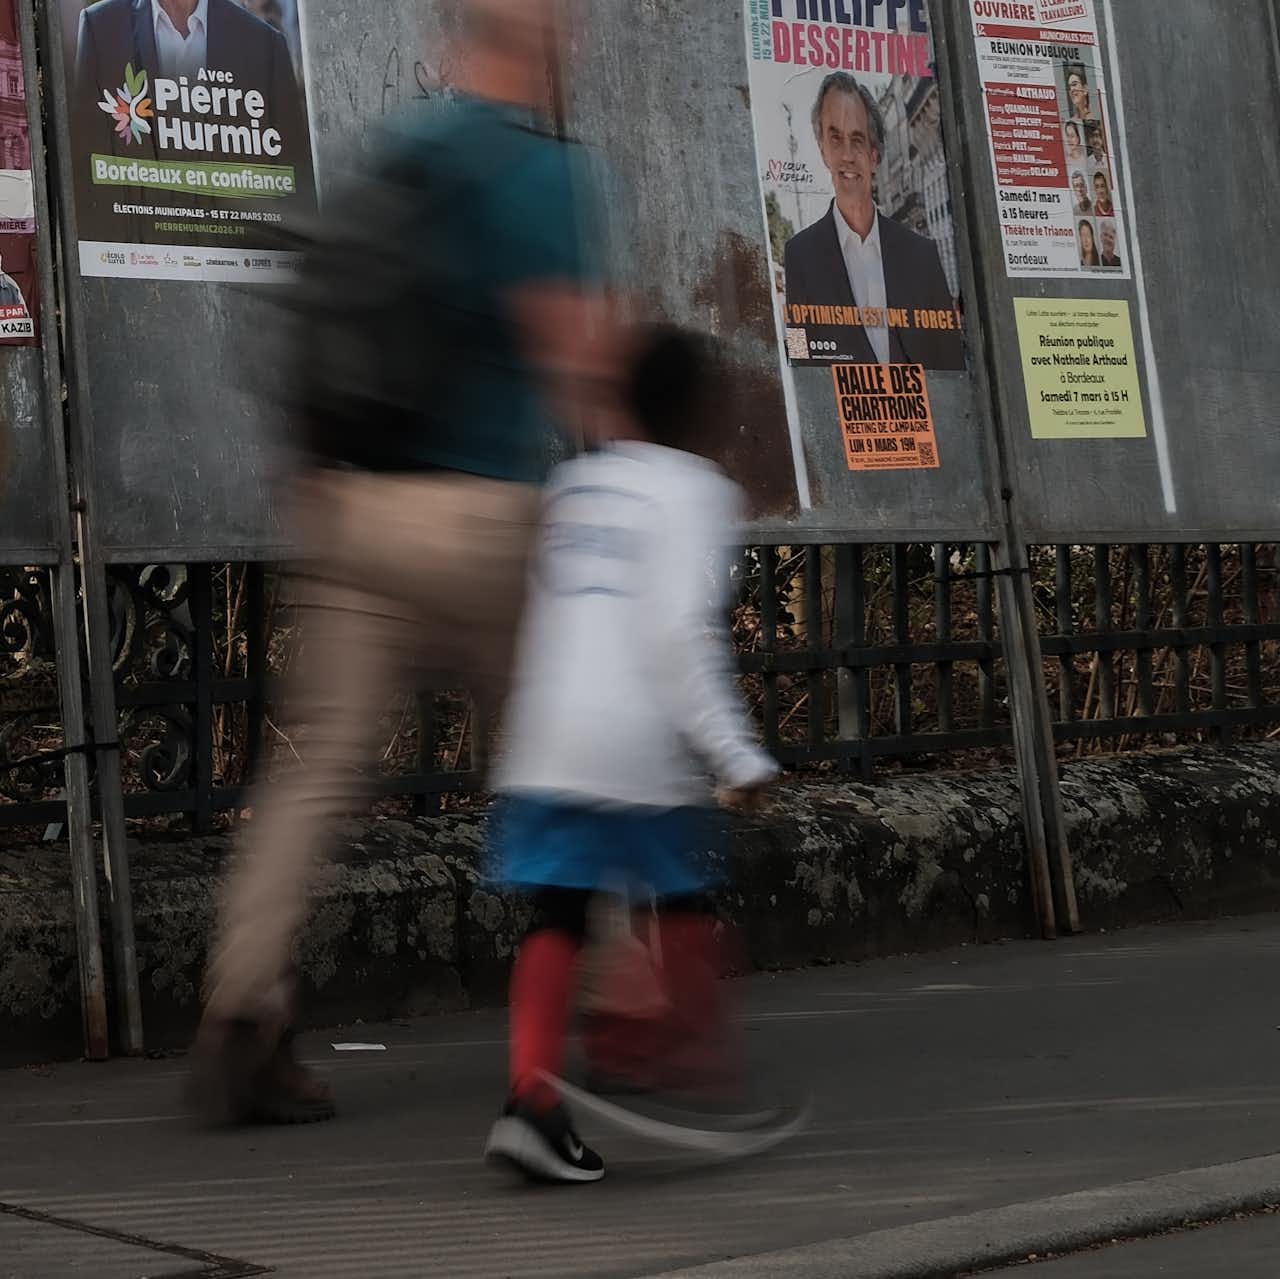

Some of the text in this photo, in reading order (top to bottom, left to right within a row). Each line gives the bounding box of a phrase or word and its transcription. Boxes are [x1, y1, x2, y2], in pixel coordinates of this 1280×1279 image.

[974, 0, 1036, 20] OUVRIÈRE
[1040, 4, 1084, 21] TRAVAILLEURS
[772, 20, 935, 78] DESSERTINE
[990, 38, 1034, 56] RÉUNION
[1035, 44, 1080, 60] PUBLIQUE
[197, 67, 234, 83] Avec
[154, 76, 265, 119] Pierre
[1016, 87, 1056, 100] ARTHAUD
[158, 116, 282, 157] Hurmic
[95, 159, 293, 192] Bordeaux en confiance
[999, 190, 1061, 203] Samedi 7 mars
[1002, 206, 1049, 220] à 15 heures
[1004, 224, 1074, 237] Théâtre le Trianon
[1008, 253, 1049, 265] Bordeaux
[6, 307, 23, 318] PAR
[783, 303, 862, 325] L'OPTIMISME
[862, 306, 883, 327] EST
[887, 307, 910, 328] UNE
[913, 309, 954, 329] FORCE
[2, 321, 32, 334] KAZIB
[1039, 335, 1114, 349] Réunion publique
[1031, 354, 1128, 366] avec Nathalie Arthaud
[835, 365, 923, 395] HALLE DES
[1060, 371, 1105, 384] à Bordeaux
[1040, 390, 1129, 402] Samedi 7 mars à 15 H
[841, 395, 928, 421] CHARTRONS
[845, 421, 930, 434] MEETING DE CAMPAGNE
[848, 437, 916, 453] LUN 9 MARS 19H
